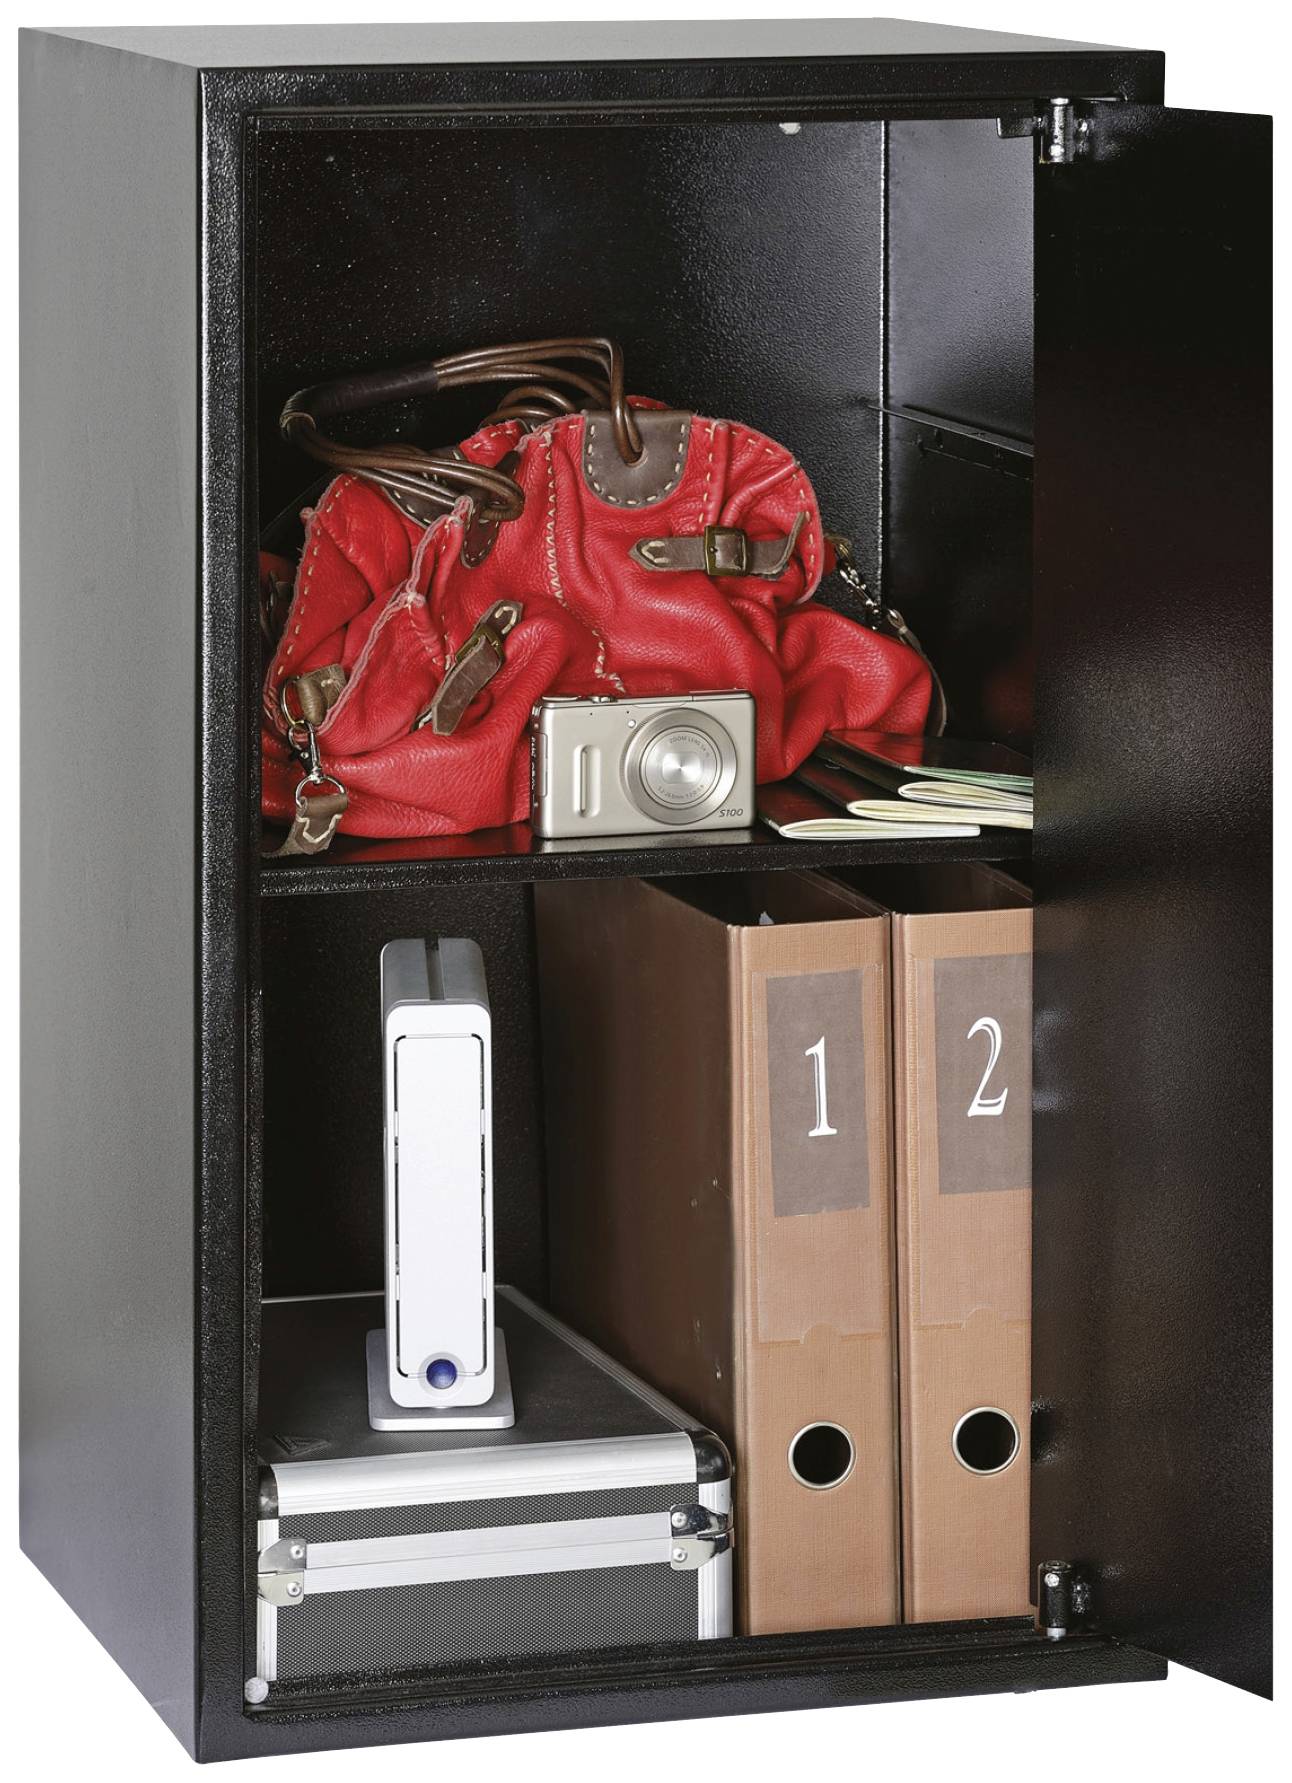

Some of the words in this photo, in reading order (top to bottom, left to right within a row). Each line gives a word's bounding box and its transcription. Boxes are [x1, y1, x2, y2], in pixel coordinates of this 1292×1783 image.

[719, 808, 744, 818] S100
[804, 1035, 838, 1137] 1
[967, 1016, 1008, 1118] 2
